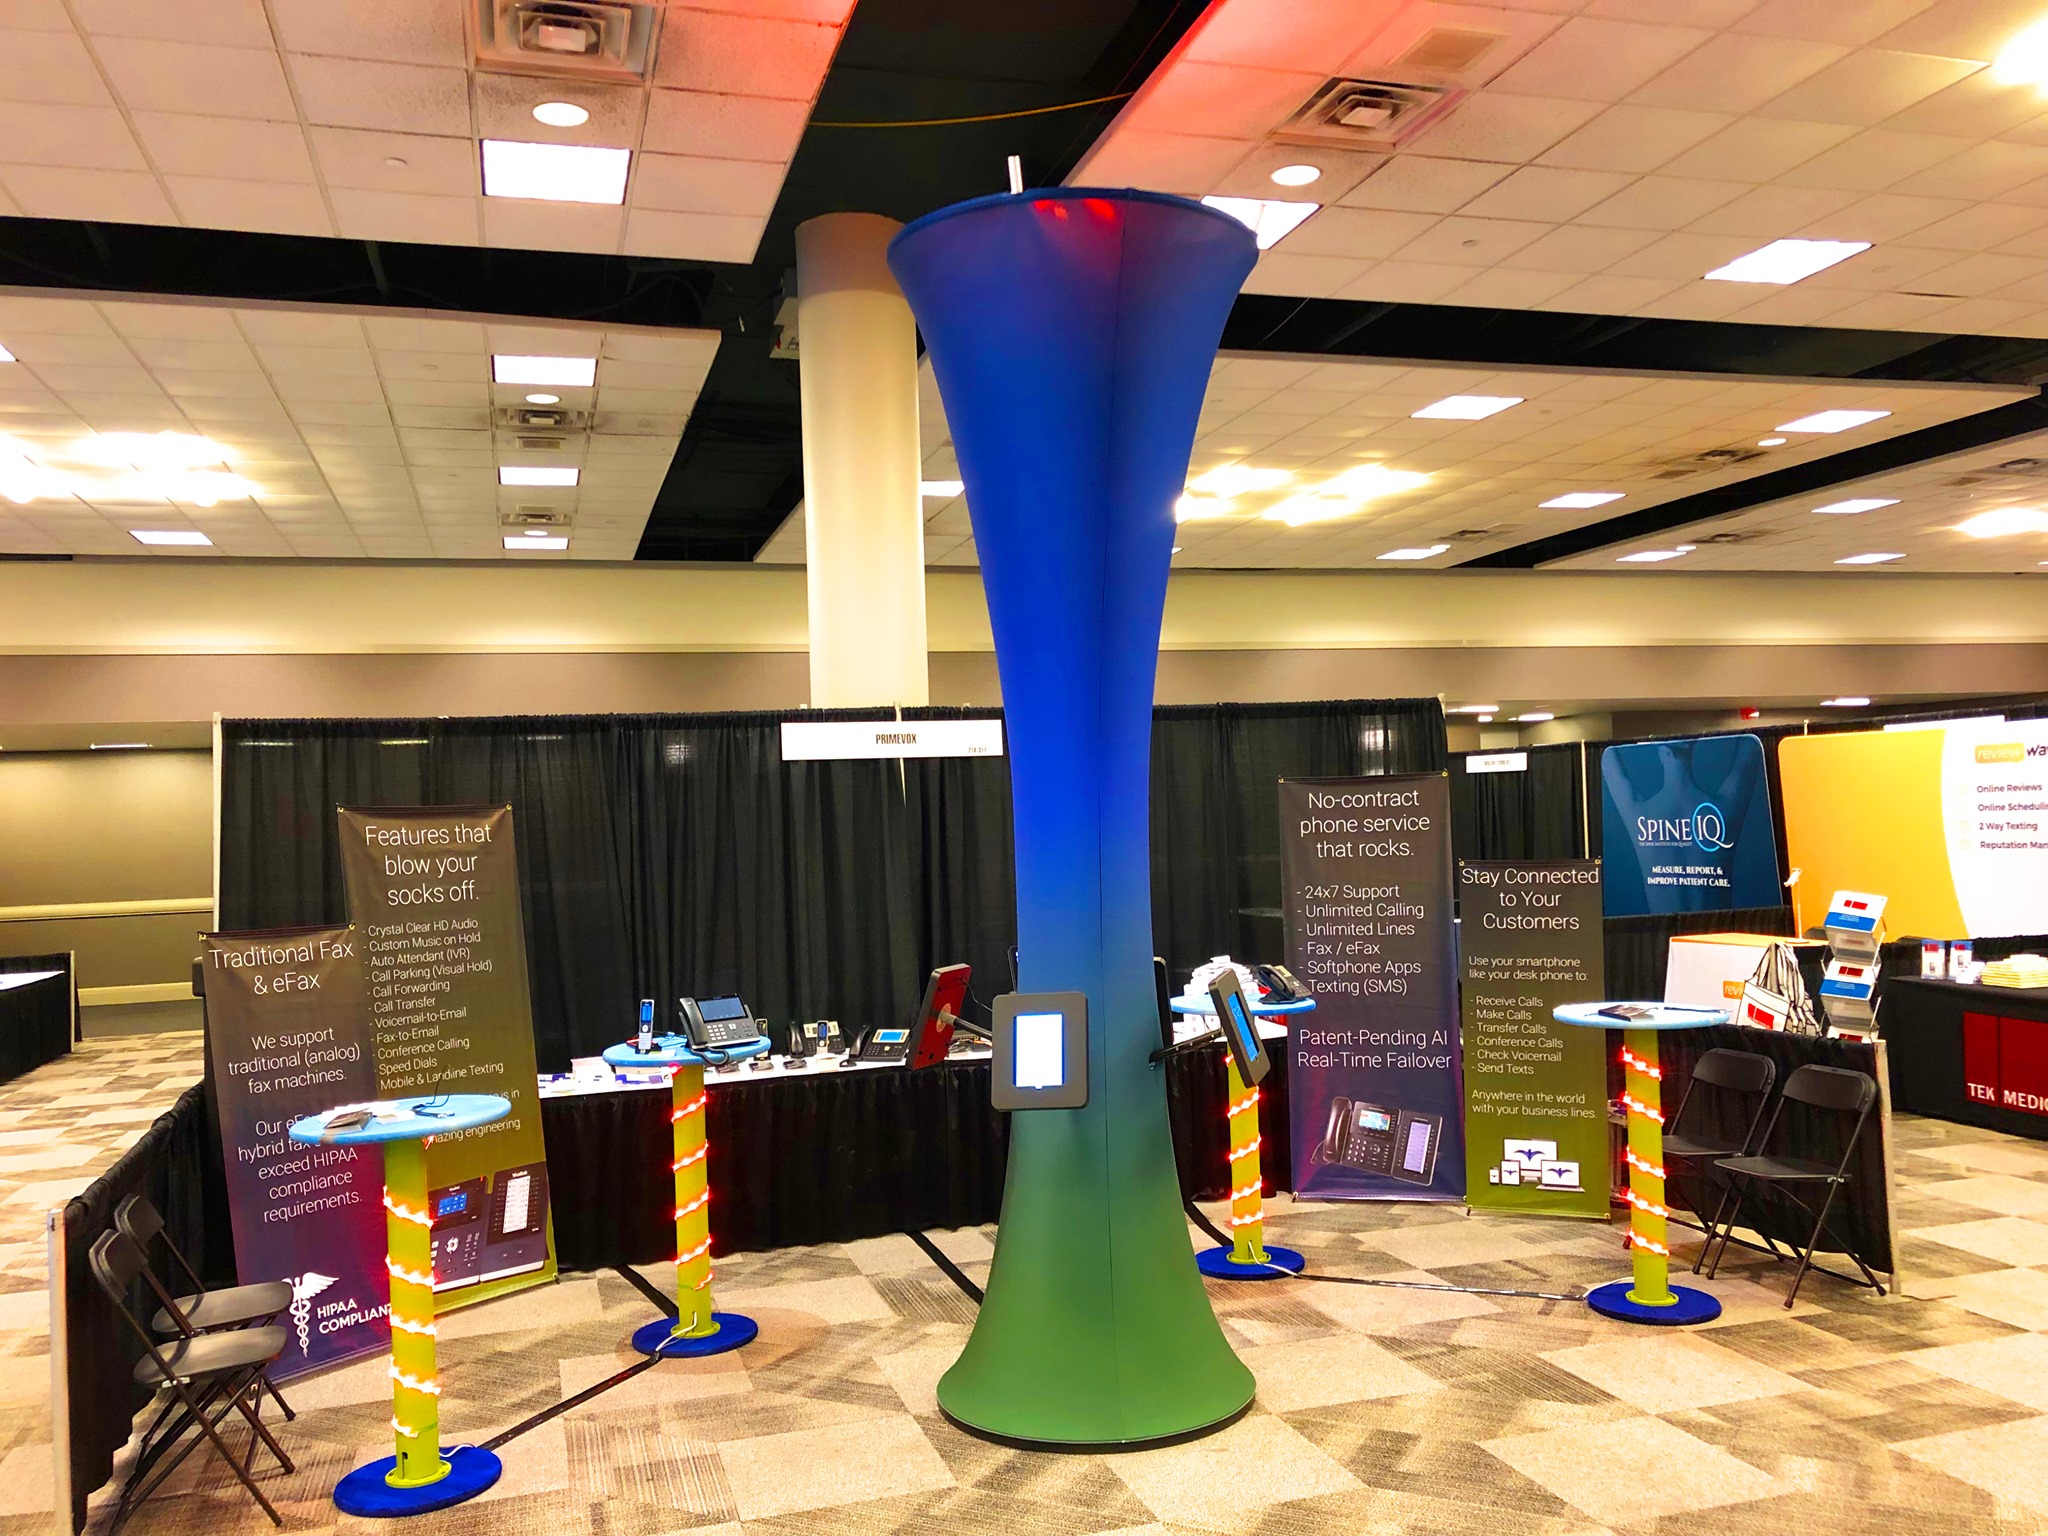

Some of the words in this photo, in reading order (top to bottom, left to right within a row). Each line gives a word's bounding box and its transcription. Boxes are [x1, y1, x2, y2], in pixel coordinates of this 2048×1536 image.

[876, 733, 917, 744] PRIMEVOX
[2026, 744, 2048, 757] wa
[1976, 785, 2004, 793] Online
[2006, 783, 2043, 792] Reviews
[1308, 790, 1419, 809] No-contract
[1978, 803, 2006, 811] Online
[365, 826, 450, 846] Features
[454, 823, 492, 844] that
[1300, 816, 1358, 838] phone
[1363, 813, 1430, 832] service
[1637, 816, 1693, 841] SPINE
[1696, 814, 1734, 849] IQ
[1979, 822, 1984, 830] 2
[1985, 822, 2004, 831] Way
[2005, 821, 2038, 831] Texting
[1316, 840, 1353, 858] that
[1359, 838, 1414, 857] rocks.
[1980, 840, 2028, 850] Reputation
[385, 854, 430, 876] blow
[436, 856, 478, 878] your
[1652, 866, 1685, 875] MEASURE,
[1686, 866, 1716, 875] REPORT,
[1717, 867, 1723, 875] &
[1462, 868, 1500, 888] Stay
[1504, 867, 1599, 884] Connected
[1647, 877, 1678, 885] IMPROVE
[1679, 878, 1707, 886] PATIENT
[1709, 878, 1730, 887] CARE.
[387, 883, 444, 906] socks
[449, 880, 479, 902] off.
[1304, 885, 1339, 899] 24x7
[1343, 884, 1400, 901] Support
[1499, 891, 1517, 907] to
[1521, 891, 1562, 907] Your
[1305, 903, 1373, 918] Unlimited
[1376, 902, 1425, 919] Calling
[368, 923, 404, 939] Crystal
[405, 922, 431, 934] Clear
[433, 920, 449, 931] HD
[451, 918, 479, 930] Audio
[1306, 922, 1373, 936] Unlimited
[1377, 922, 1415, 936] Lines
[1483, 913, 1580, 930] Customers
[369, 939, 410, 952] Custom
[412, 937, 442, 949] Music
[443, 936, 457, 945] on
[458, 932, 481, 943] Hold
[1307, 941, 1333, 955] Fax
[1336, 941, 1343, 956] /
[1346, 941, 1381, 955] eFax
[208, 941, 314, 969] Traditional
[319, 940, 354, 960] Fax
[370, 956, 395, 967] Auto
[396, 951, 445, 965] Attendant
[447, 947, 470, 962] (IVR)
[1468, 956, 1489, 966] Use
[1491, 957, 1514, 968] your
[1516, 957, 1581, 968] smartphone
[371, 970, 391, 983] Call
[393, 967, 431, 980] Parking
[432, 961, 465, 979] (Visual
[467, 960, 493, 974] Hold)
[1307, 959, 1381, 976] Softphone
[1384, 960, 1422, 976] Apps
[1469, 969, 1486, 979] like
[1488, 971, 1510, 981] your
[1513, 970, 1538, 980] desk
[1540, 971, 1574, 982] phone
[254, 975, 268, 995] &
[272, 971, 321, 993] eFax
[372, 986, 392, 998] Call
[394, 981, 450, 996] Forwarding
[1307, 979, 1360, 997] Texting
[1363, 978, 1407, 996] (SMS)
[374, 1001, 393, 1014] Call
[395, 996, 436, 1010] Transfer
[1476, 995, 1516, 1006] Receive
[1517, 996, 1544, 1007] Calls
[375, 1006, 467, 1029] Voicemail-to-Email
[1476, 1009, 1505, 1019] Make
[1506, 1010, 1532, 1020] Calls
[376, 1025, 440, 1044] Fax-to-Email
[1476, 1022, 1519, 1033] Transfer
[1521, 1023, 1547, 1034] Calls
[251, 1036, 276, 1050] We
[280, 1027, 335, 1048] support
[1300, 1029, 1427, 1050] Patent-Pending
[1431, 1030, 1448, 1046] AI
[1476, 1035, 1536, 1047] Conference
[1538, 1037, 1564, 1048] Calls
[377, 1042, 436, 1060] Conference
[437, 1037, 470, 1051] Calling
[1477, 1049, 1509, 1060] Check
[1511, 1051, 1562, 1062] Voicemail
[228, 1051, 301, 1076] traditional
[304, 1042, 360, 1068] (analog)
[379, 1060, 411, 1077] Speed
[413, 1056, 438, 1070] Dials
[1298, 1052, 1382, 1068] Real-Time
[1387, 1052, 1452, 1069] Failover
[380, 1075, 415, 1091] Mobile
[416, 1073, 425, 1085] &
[426, 1067, 467, 1083] Landline
[469, 1062, 504, 1076] Texting
[1477, 1063, 1504, 1073] Send
[1506, 1063, 1534, 1075] Texts
[248, 1079, 272, 1094] fax
[275, 1068, 347, 1090] machines.
[511, 1088, 520, 1099] in
[1472, 1089, 1523, 1102] Anywhere
[1525, 1092, 1534, 1102] in
[1536, 1092, 1554, 1103] the
[1556, 1094, 1585, 1104] world
[1967, 1082, 1995, 1102] TEK
[1472, 1104, 1494, 1113] with
[1496, 1106, 1519, 1117] your
[1521, 1105, 1568, 1117] business
[256, 1120, 282, 1136] Our
[466, 1118, 521, 1138] engineering
[238, 1139, 285, 1164] hybrid
[258, 1156, 310, 1180] exceed
[314, 1147, 358, 1169] HIPAA
[269, 1171, 353, 1200] compliance
[264, 1191, 363, 1223] requirements.
[317, 1298, 358, 1319] HIPAA
